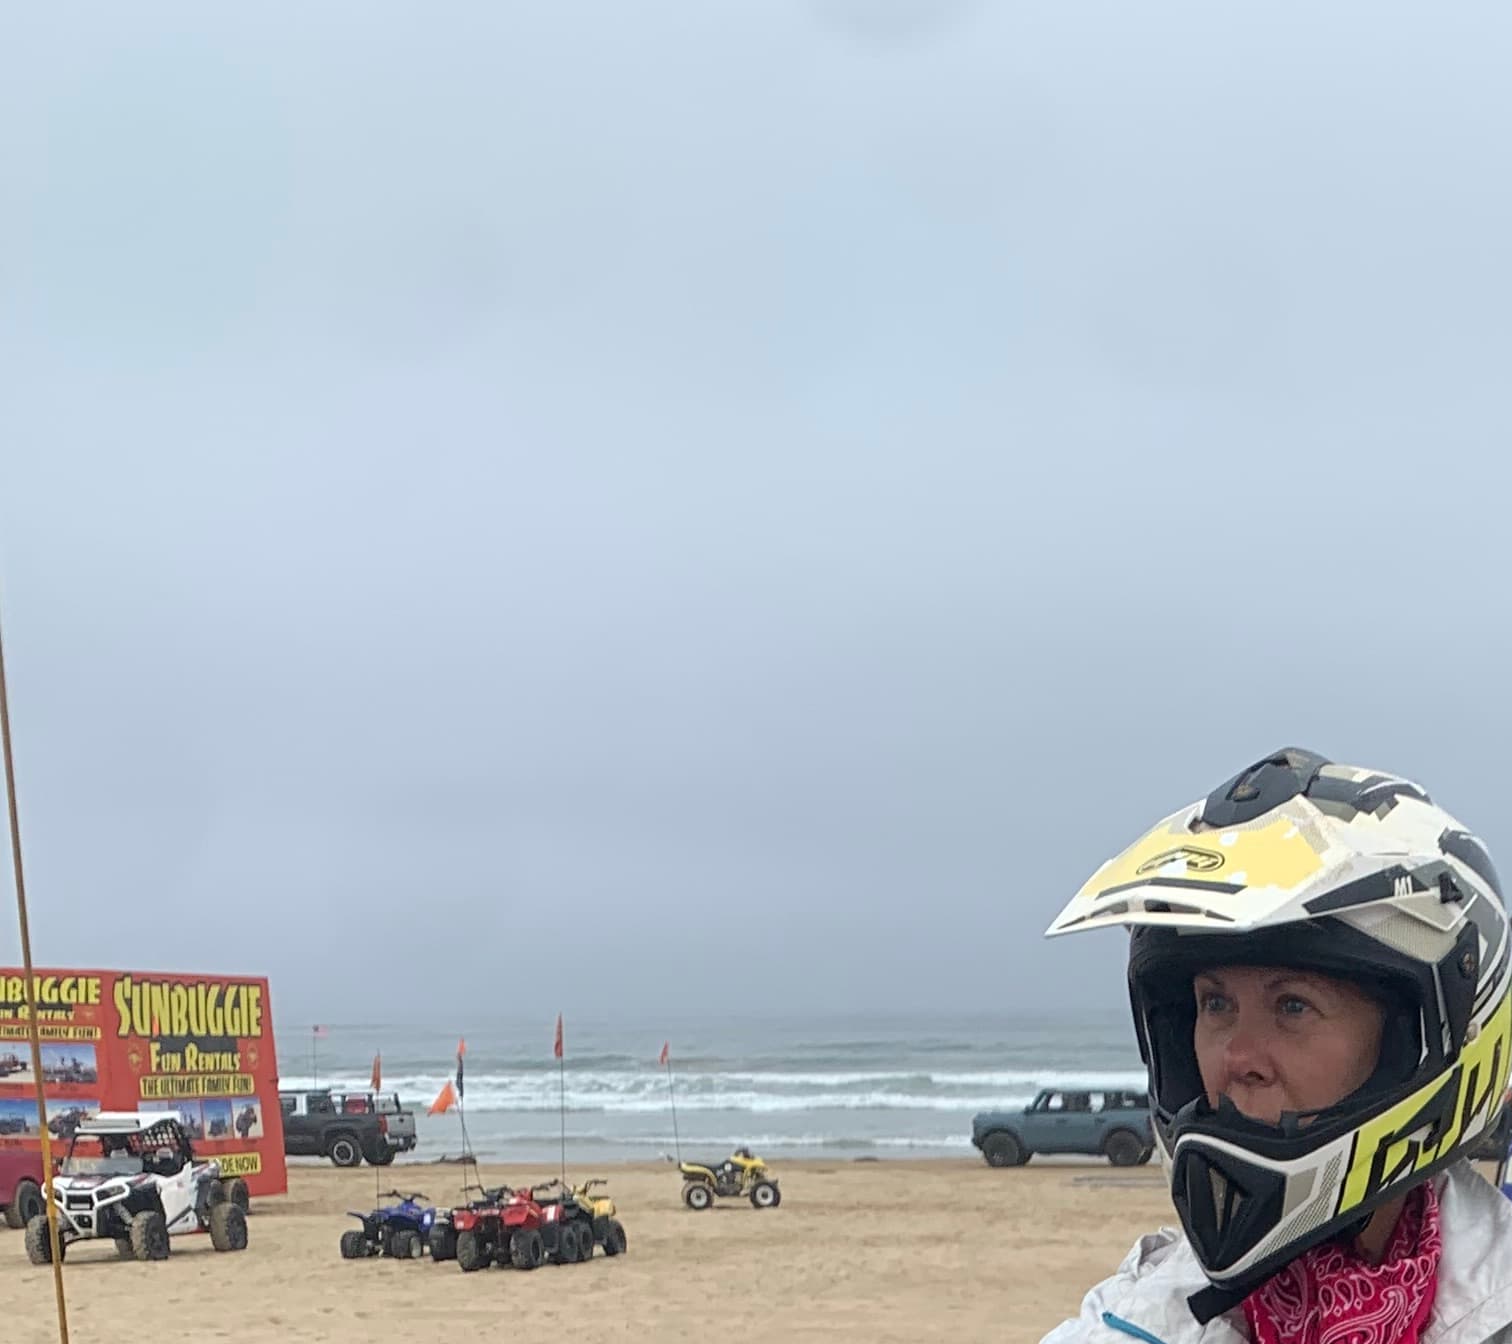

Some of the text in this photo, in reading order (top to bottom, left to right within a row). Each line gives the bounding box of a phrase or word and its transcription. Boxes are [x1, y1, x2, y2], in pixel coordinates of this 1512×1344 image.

[0, 976, 101, 1004] BUGGIE
[17, 1004, 75, 1022] RNTALS
[114, 975, 262, 1037] SUNBUGGIE
[150, 1041, 241, 1072] FUN RENTALS
[142, 1078, 158, 1095] THE
[160, 1076, 199, 1095] ULTIMATE
[202, 1075, 231, 1094] FAMILY
[236, 1156, 258, 1171] NOW
